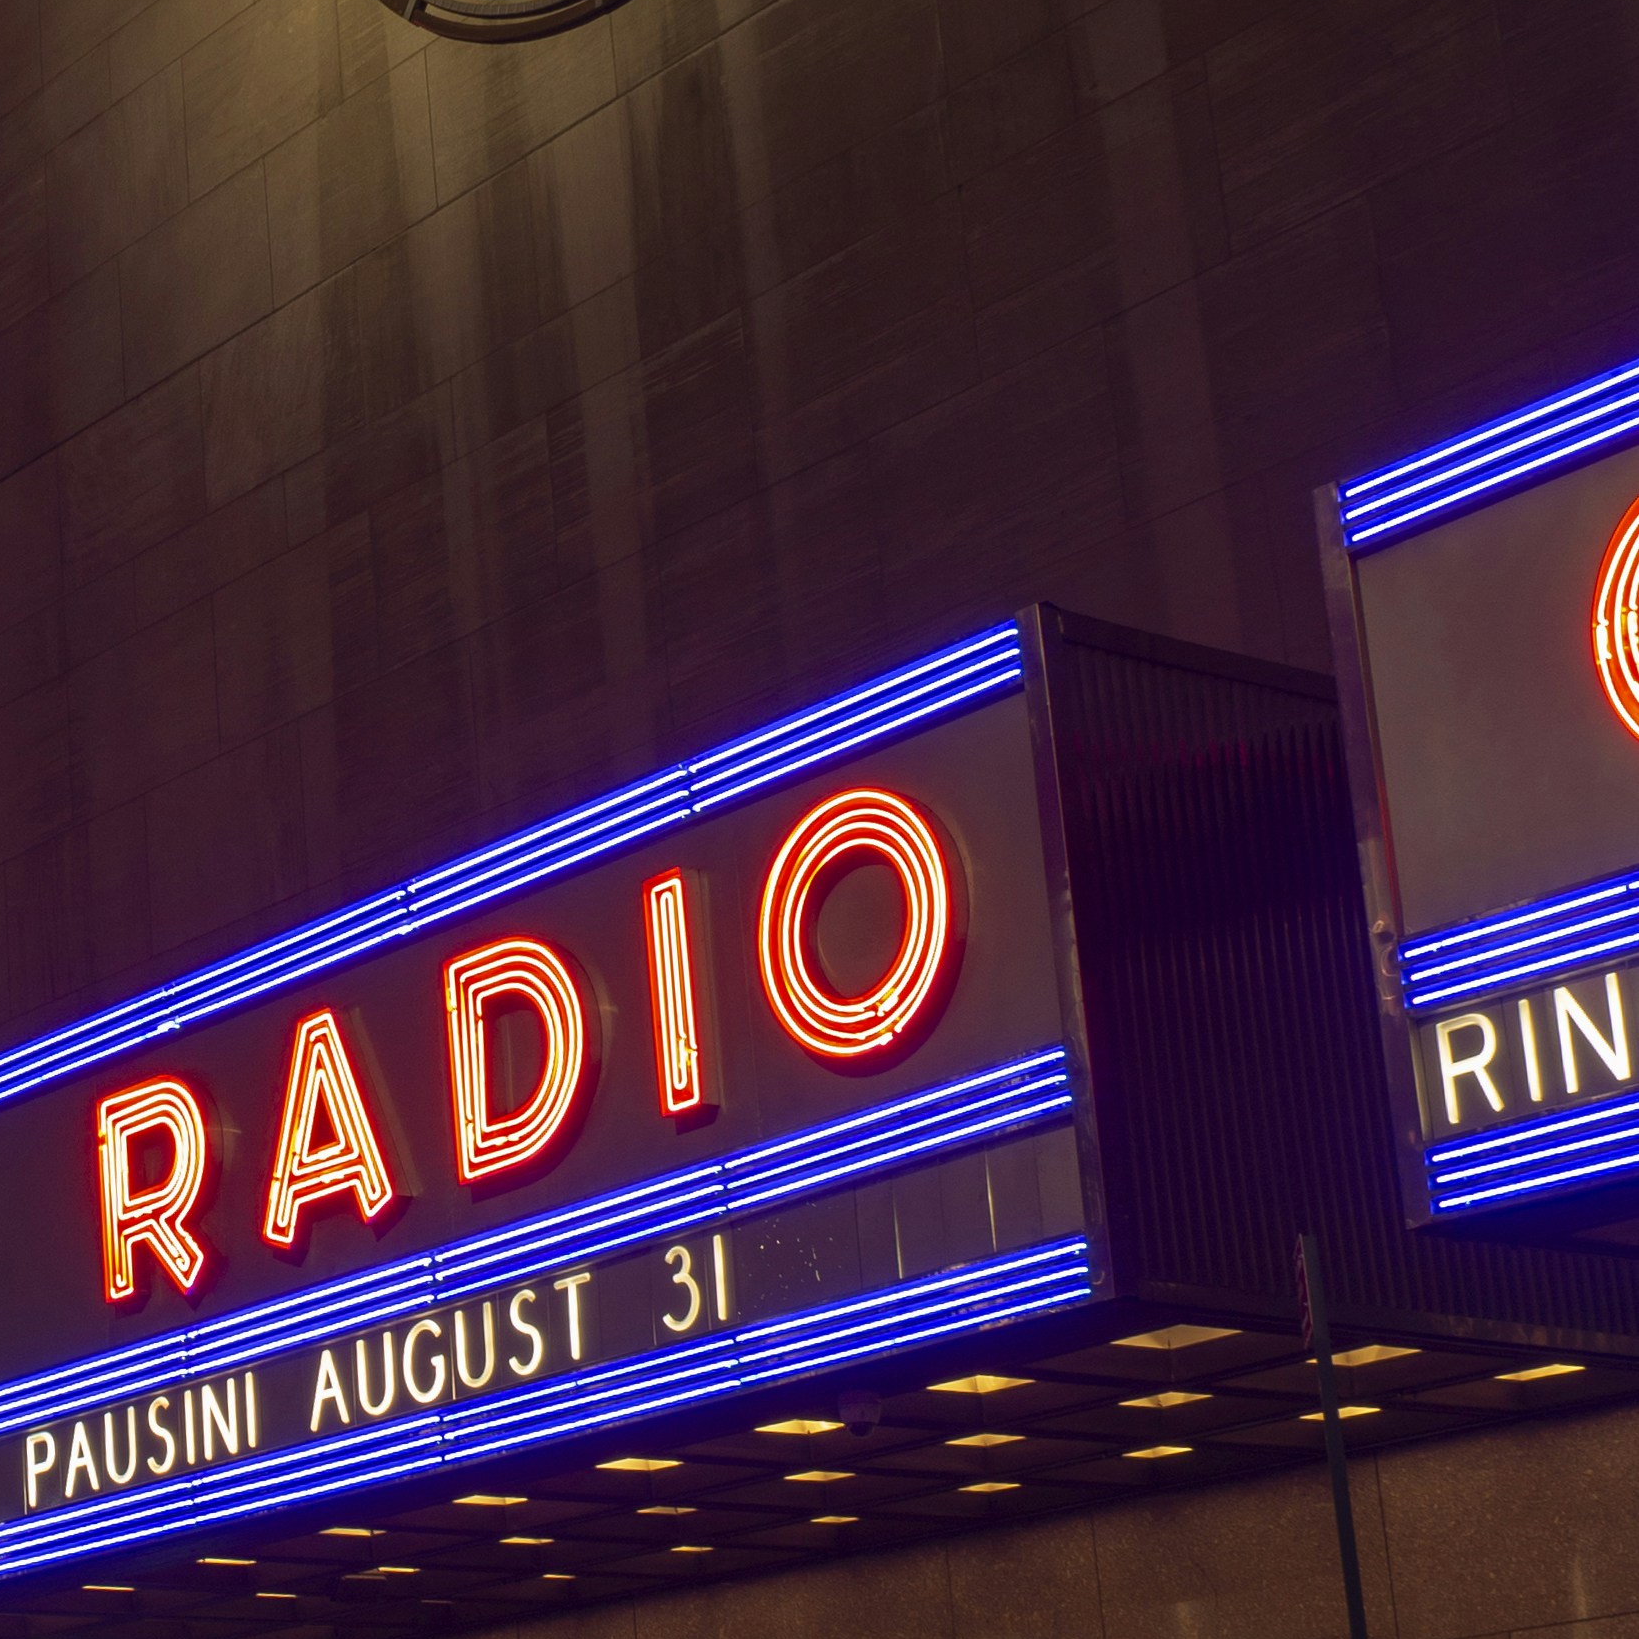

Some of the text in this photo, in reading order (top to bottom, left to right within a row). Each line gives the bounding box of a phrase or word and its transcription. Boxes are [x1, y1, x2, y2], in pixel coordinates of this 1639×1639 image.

[97, 786, 953, 1304] RADIO
[25, 1371, 257, 1508] PAUSINI
[310, 1274, 591, 1431] AUGUST
[663, 1234, 729, 1333] 31
